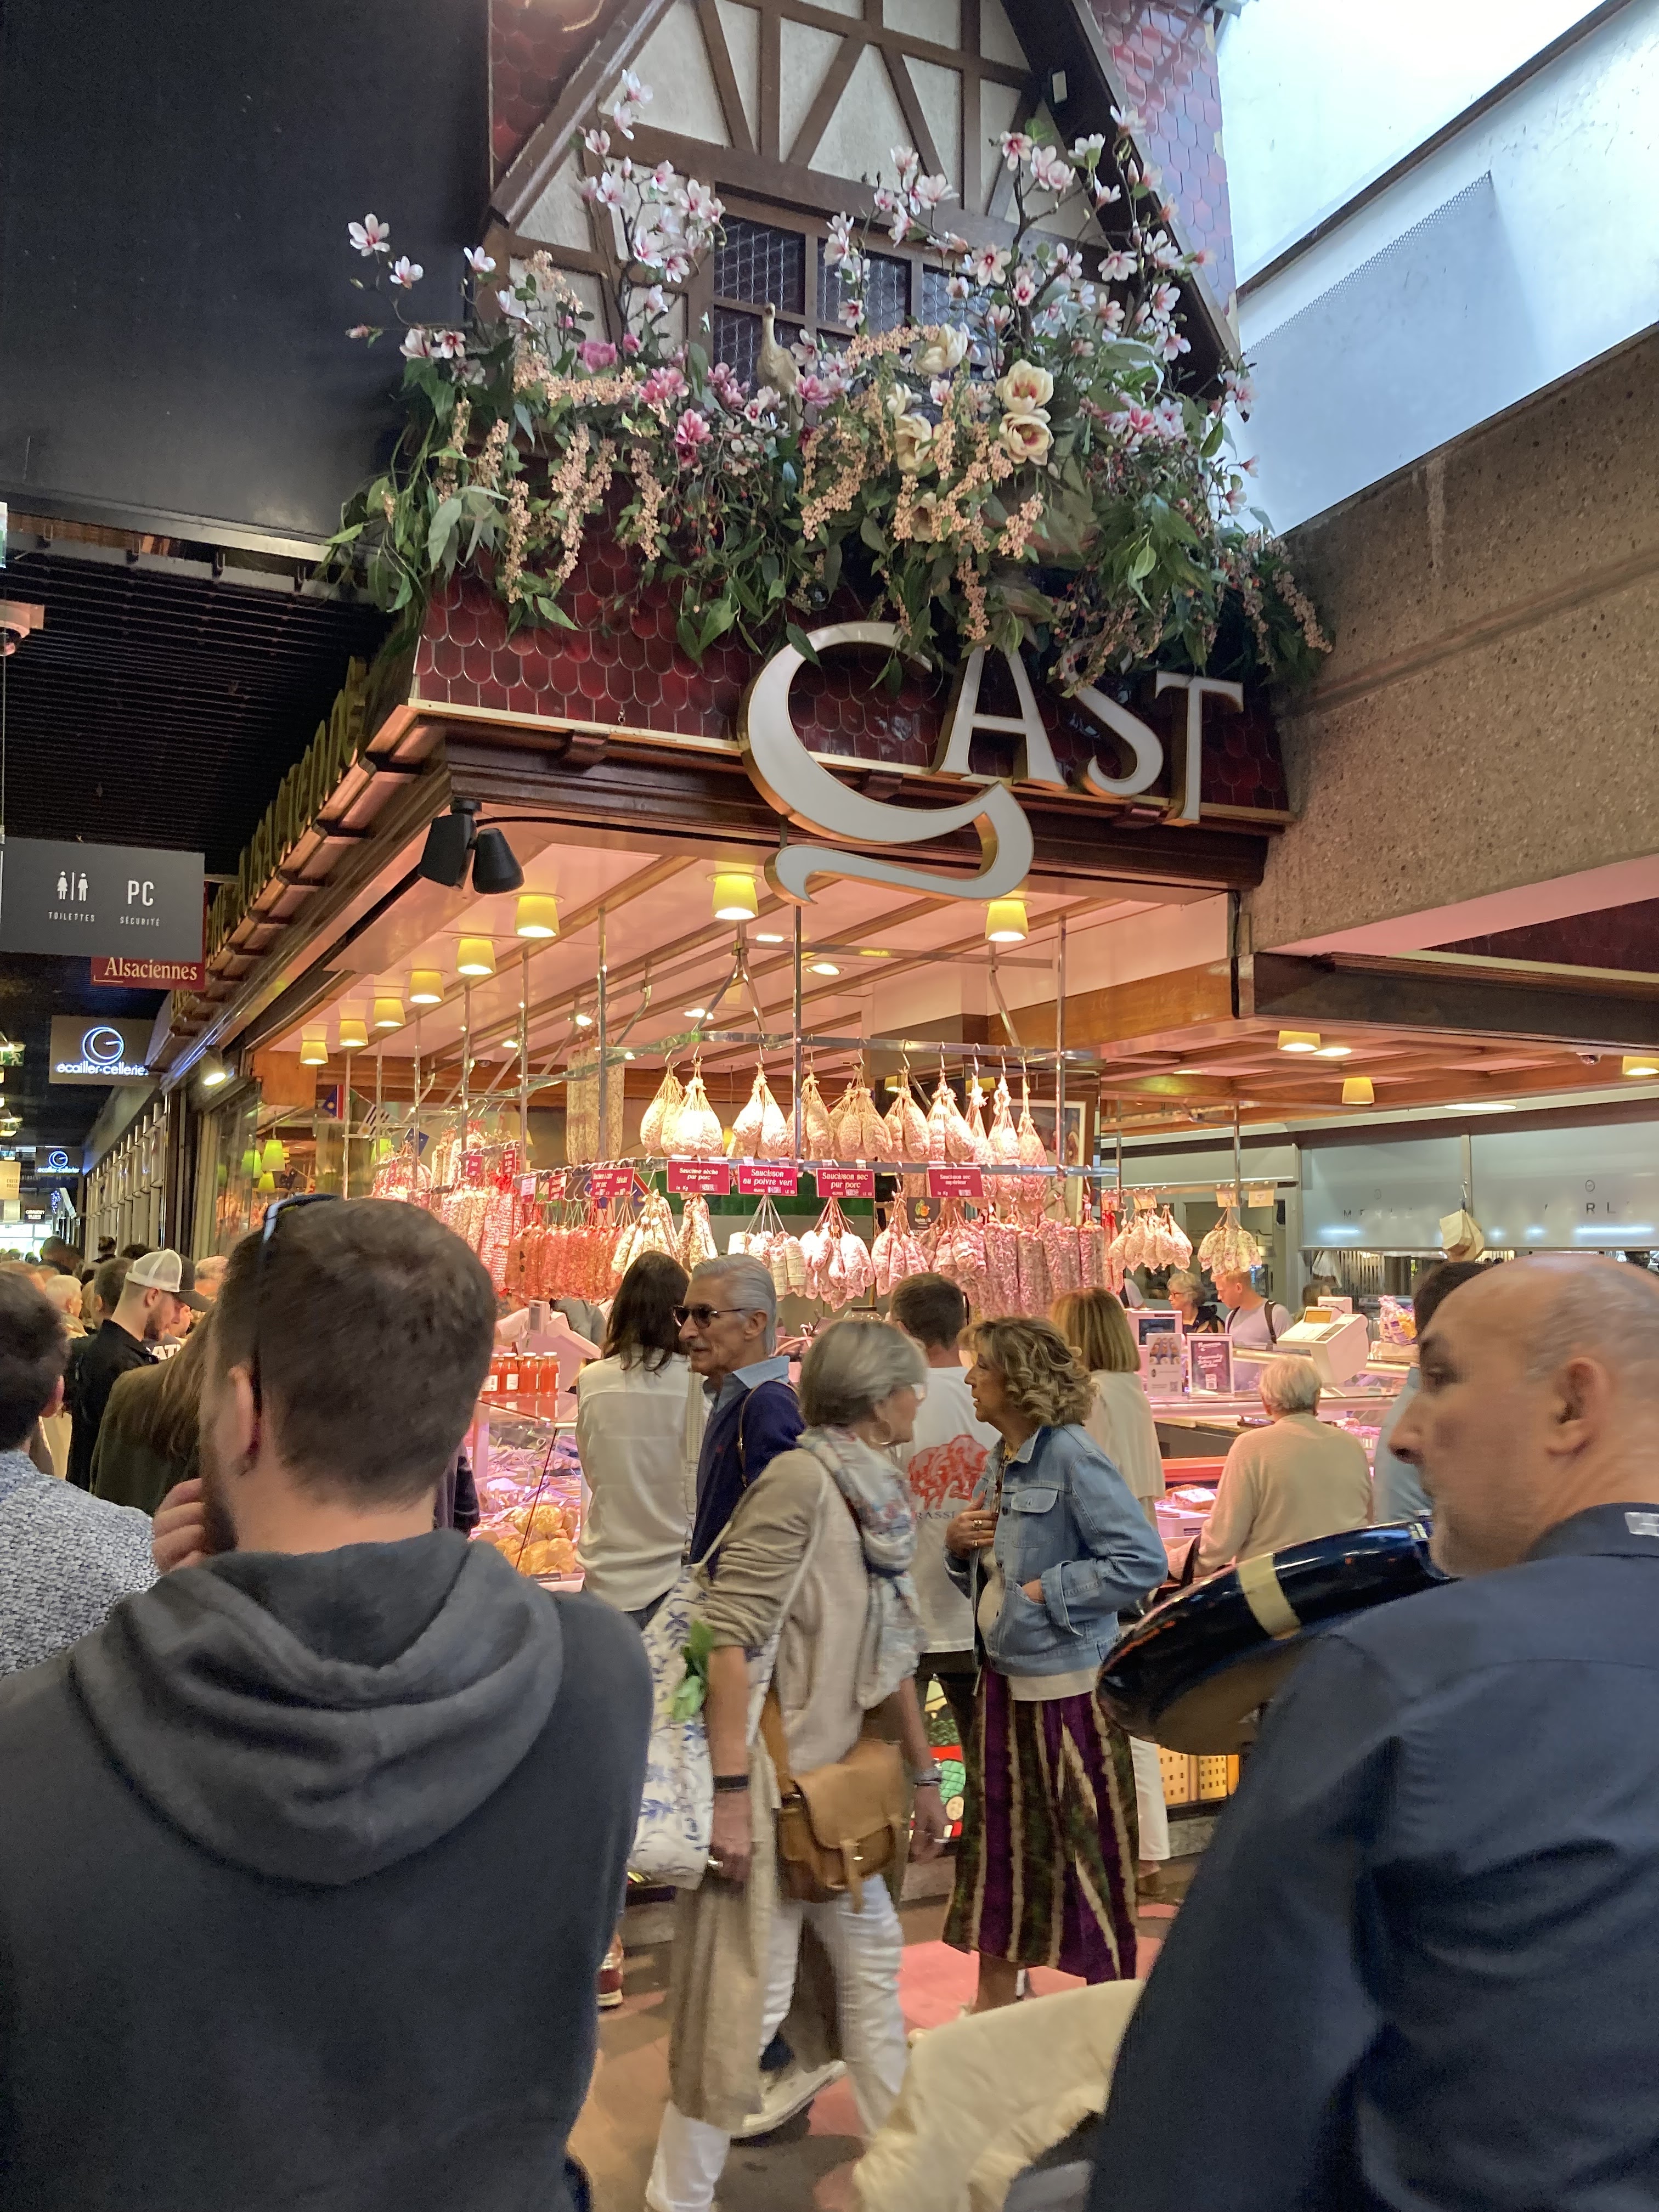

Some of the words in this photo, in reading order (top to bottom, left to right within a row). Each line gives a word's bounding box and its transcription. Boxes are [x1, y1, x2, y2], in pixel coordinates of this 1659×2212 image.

[127, 880, 154, 906] PC
[48, 911, 95, 922] TOILETTES
[120, 916, 160, 927] SÉCURITÉ
[104, 957, 198, 981] Alsaciennes
[753, 1178, 777, 1187] poivre
